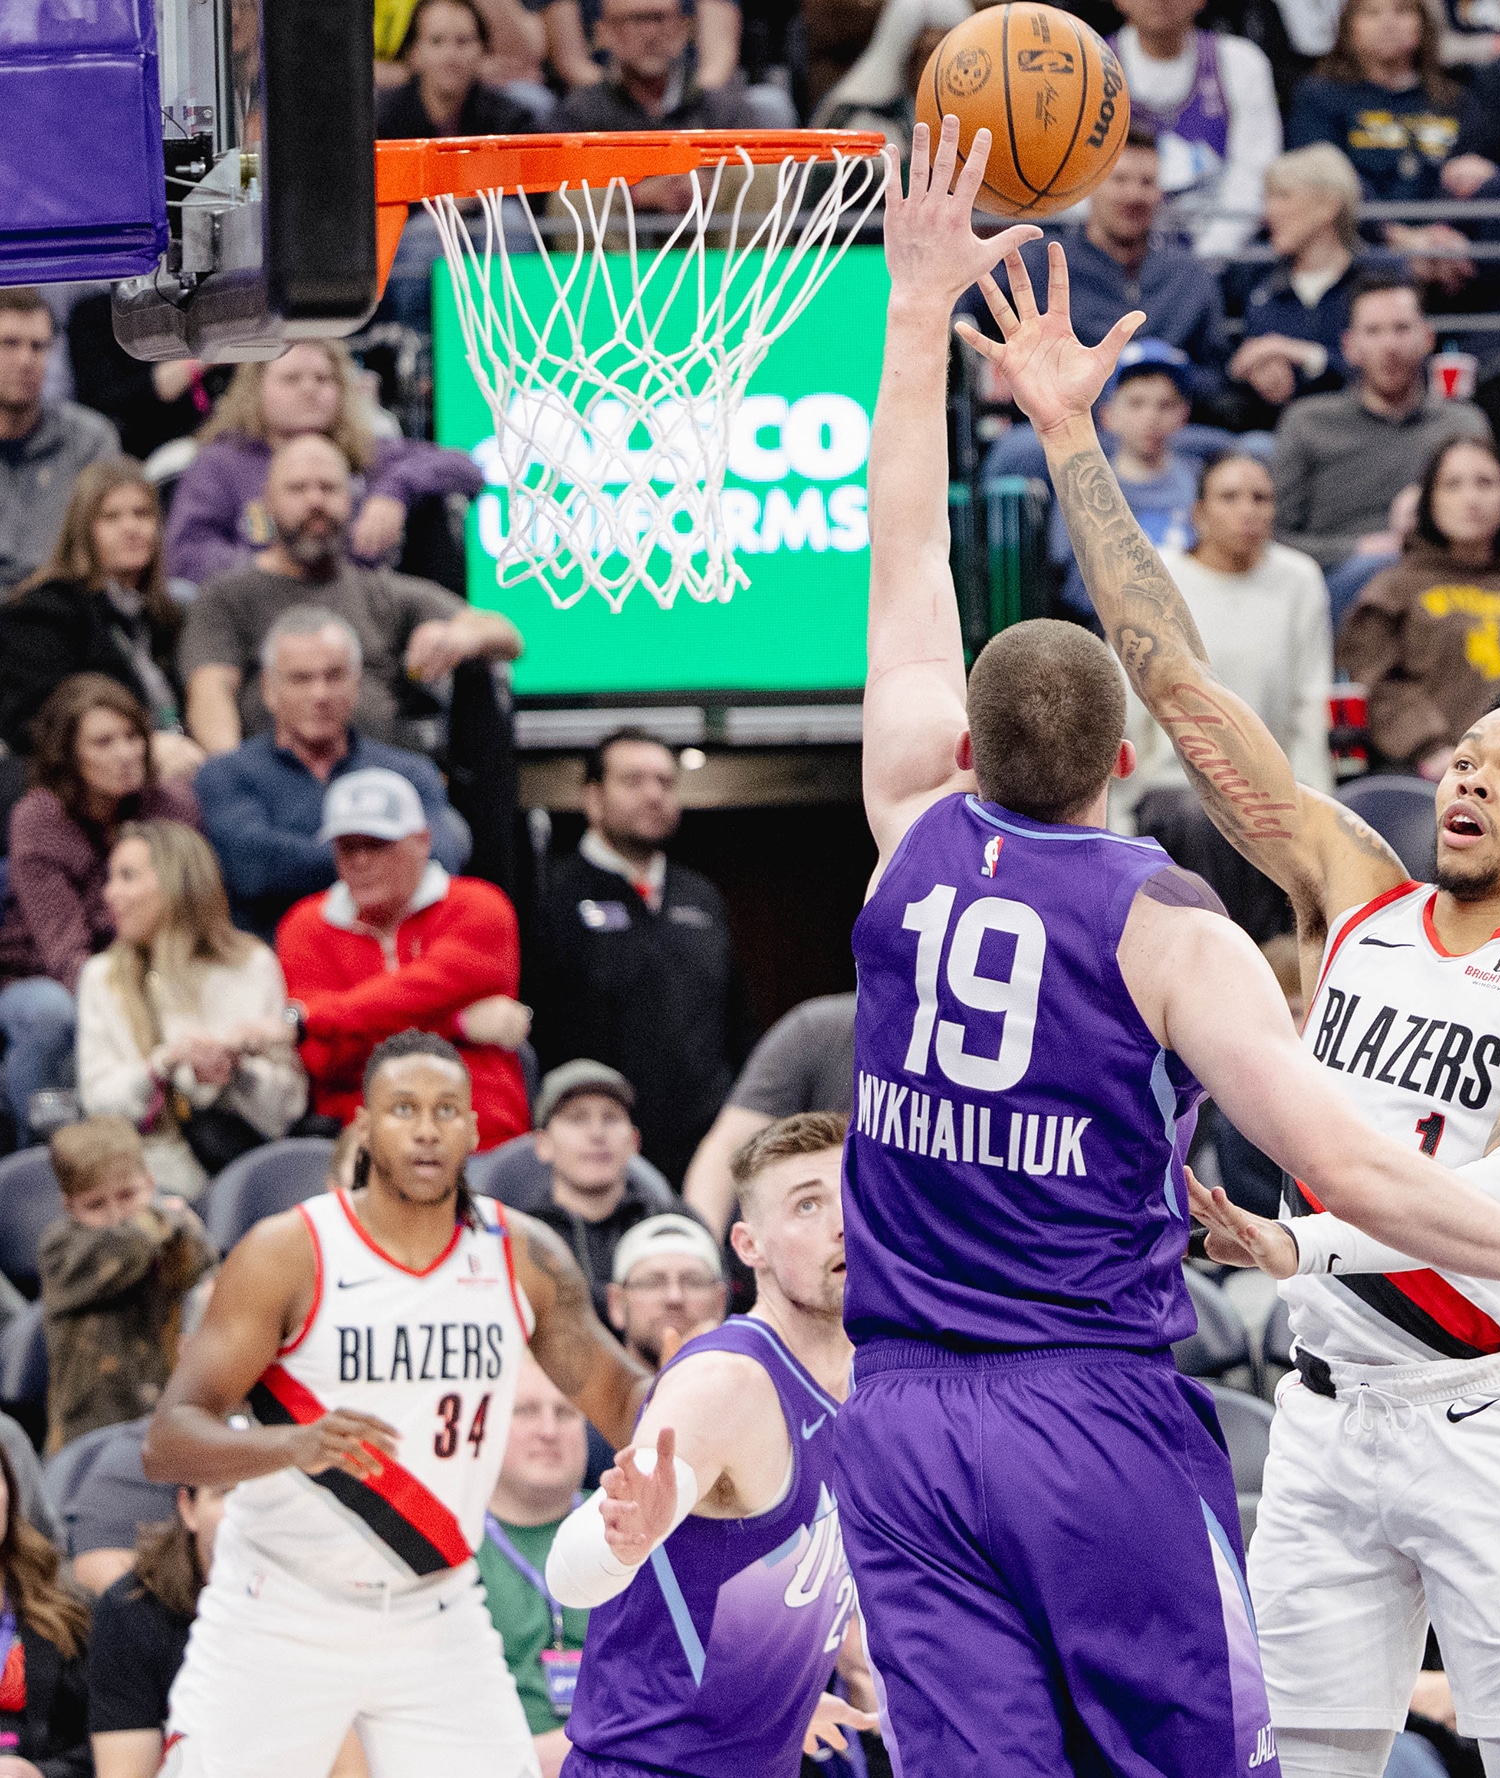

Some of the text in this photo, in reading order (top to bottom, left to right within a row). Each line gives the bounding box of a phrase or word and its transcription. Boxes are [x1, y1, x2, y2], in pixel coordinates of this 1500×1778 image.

[478, 485, 872, 559] UNIFORMS
[1161, 682, 1297, 840] Family
[902, 883, 1047, 1093] 19
[857, 1069, 1093, 1177] MYKHAILIUK
[1415, 1111, 1446, 1159] 1
[335, 1322, 504, 1384] BLAZERS
[434, 1391, 493, 1459] 34
[823, 1574, 859, 1654] 2
